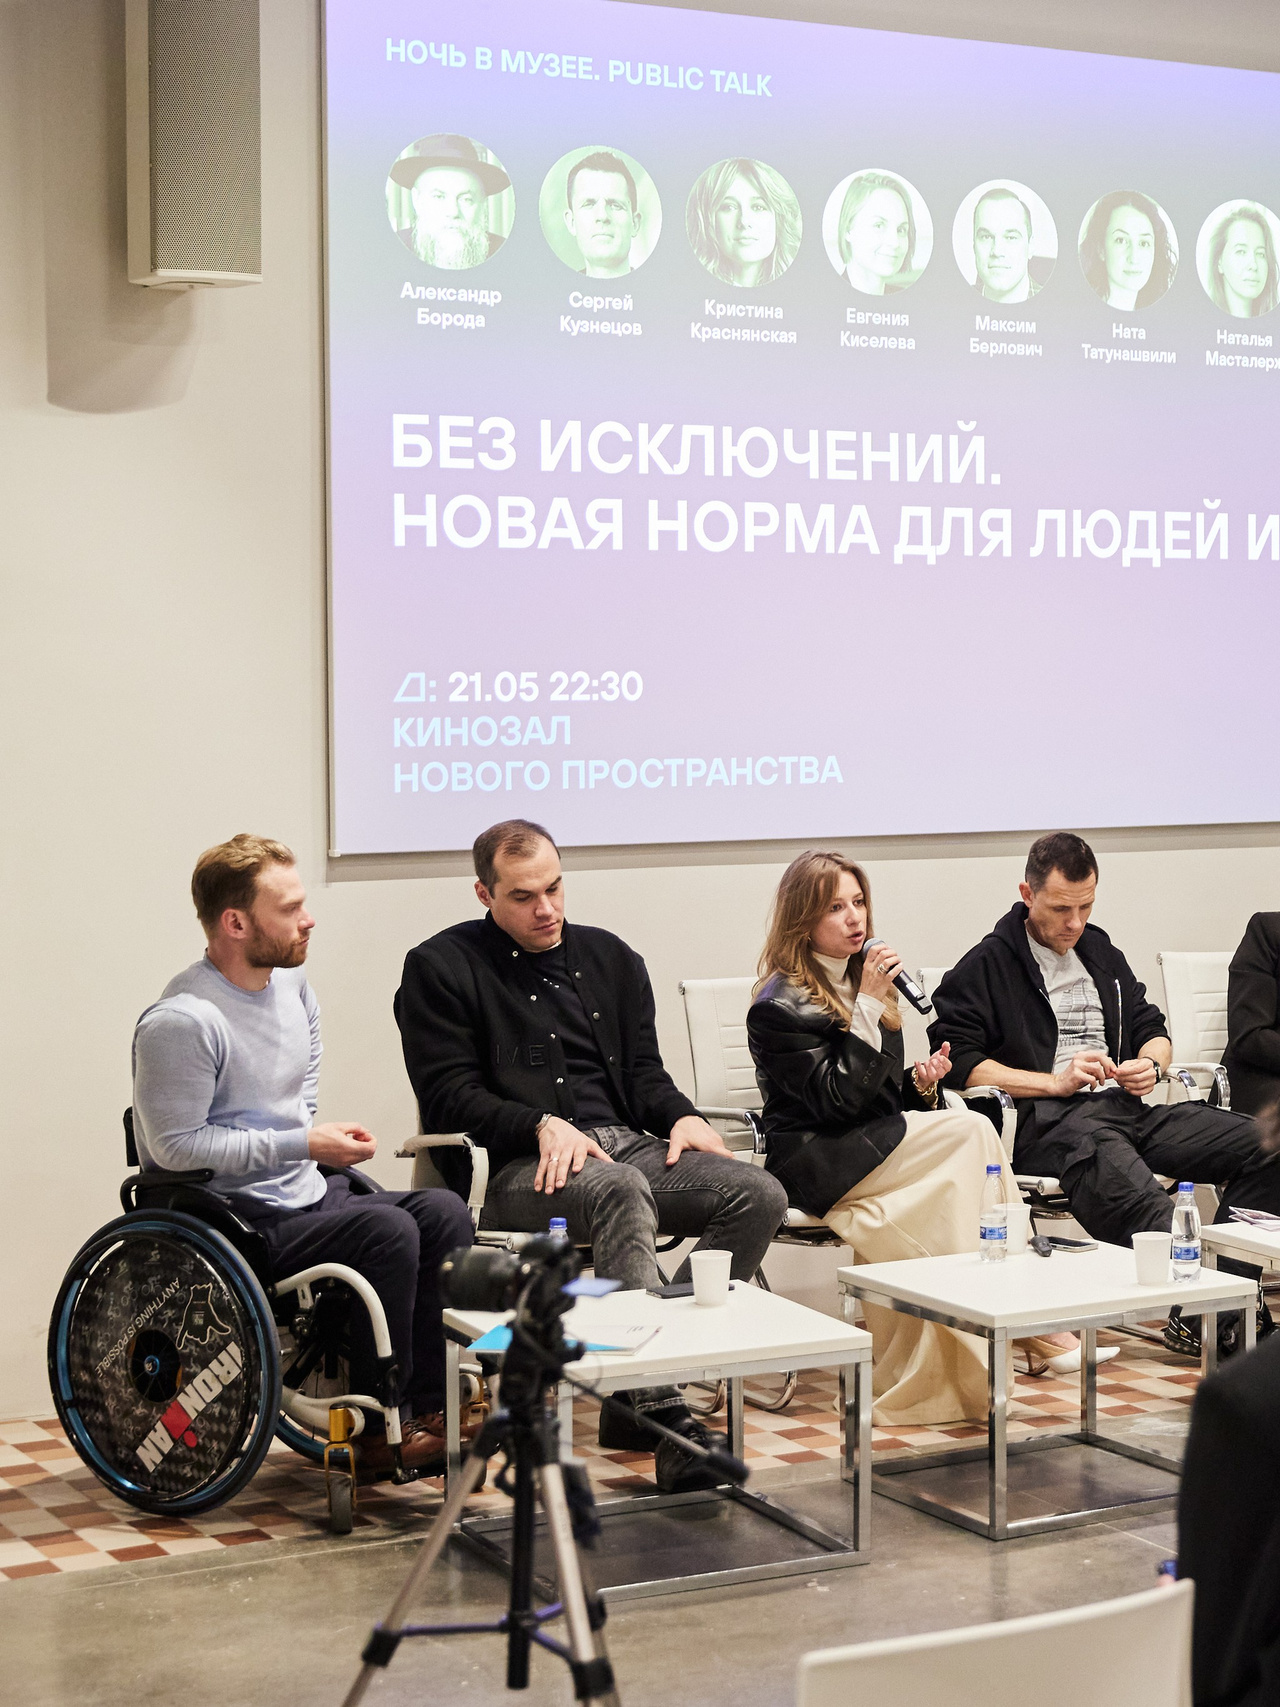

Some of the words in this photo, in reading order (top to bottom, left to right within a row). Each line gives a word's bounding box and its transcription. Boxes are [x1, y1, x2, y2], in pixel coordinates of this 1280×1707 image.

[386, 38, 467, 67] НОЧЬ
[475, 46, 493, 70] В
[501, 49, 600, 81] МУЗЕЕ.
[609, 60, 704, 92] PUBLIC
[710, 70, 773, 97] TALK
[400, 281, 502, 306] Александр
[569, 291, 634, 313] Сергей
[416, 308, 485, 329] Борода
[704, 299, 784, 320] Кристина
[846, 308, 909, 328] Евгения
[560, 316, 643, 338] Кузнецов
[690, 323, 797, 344] Краснянская
[975, 315, 1036, 334] Максим
[1112, 324, 1146, 340] Ната
[840, 332, 916, 350] Киселева
[969, 337, 1043, 357] Берлович
[1216, 329, 1273, 348] Наталья
[1082, 344, 1176, 365] Татунашвили
[392, 413, 516, 469] БЕЗ
[541, 419, 1001, 485] ИСКЛЮЧЕНИЙ.
[393, 493, 623, 549] НОВАЯ
[648, 499, 880, 554] НОРМА
[894, 505, 1012, 565] ДЛЯ
[1030, 498, 1229, 568] ЛЮДЕЙ
[1247, 513, 1280, 561] И
[448, 671, 539, 703] 21.05
[549, 671, 643, 702] 22:30
[393, 715, 572, 748] КИНОЗАЛ
[393, 760, 551, 793] НОВОГО
[562, 755, 844, 789] ПРОСТРАНСТВА
[135, 1277, 180, 1328] ANYTHING
[127, 1324, 137, 1338] IS
[94, 1333, 130, 1378] POSSIBLE
